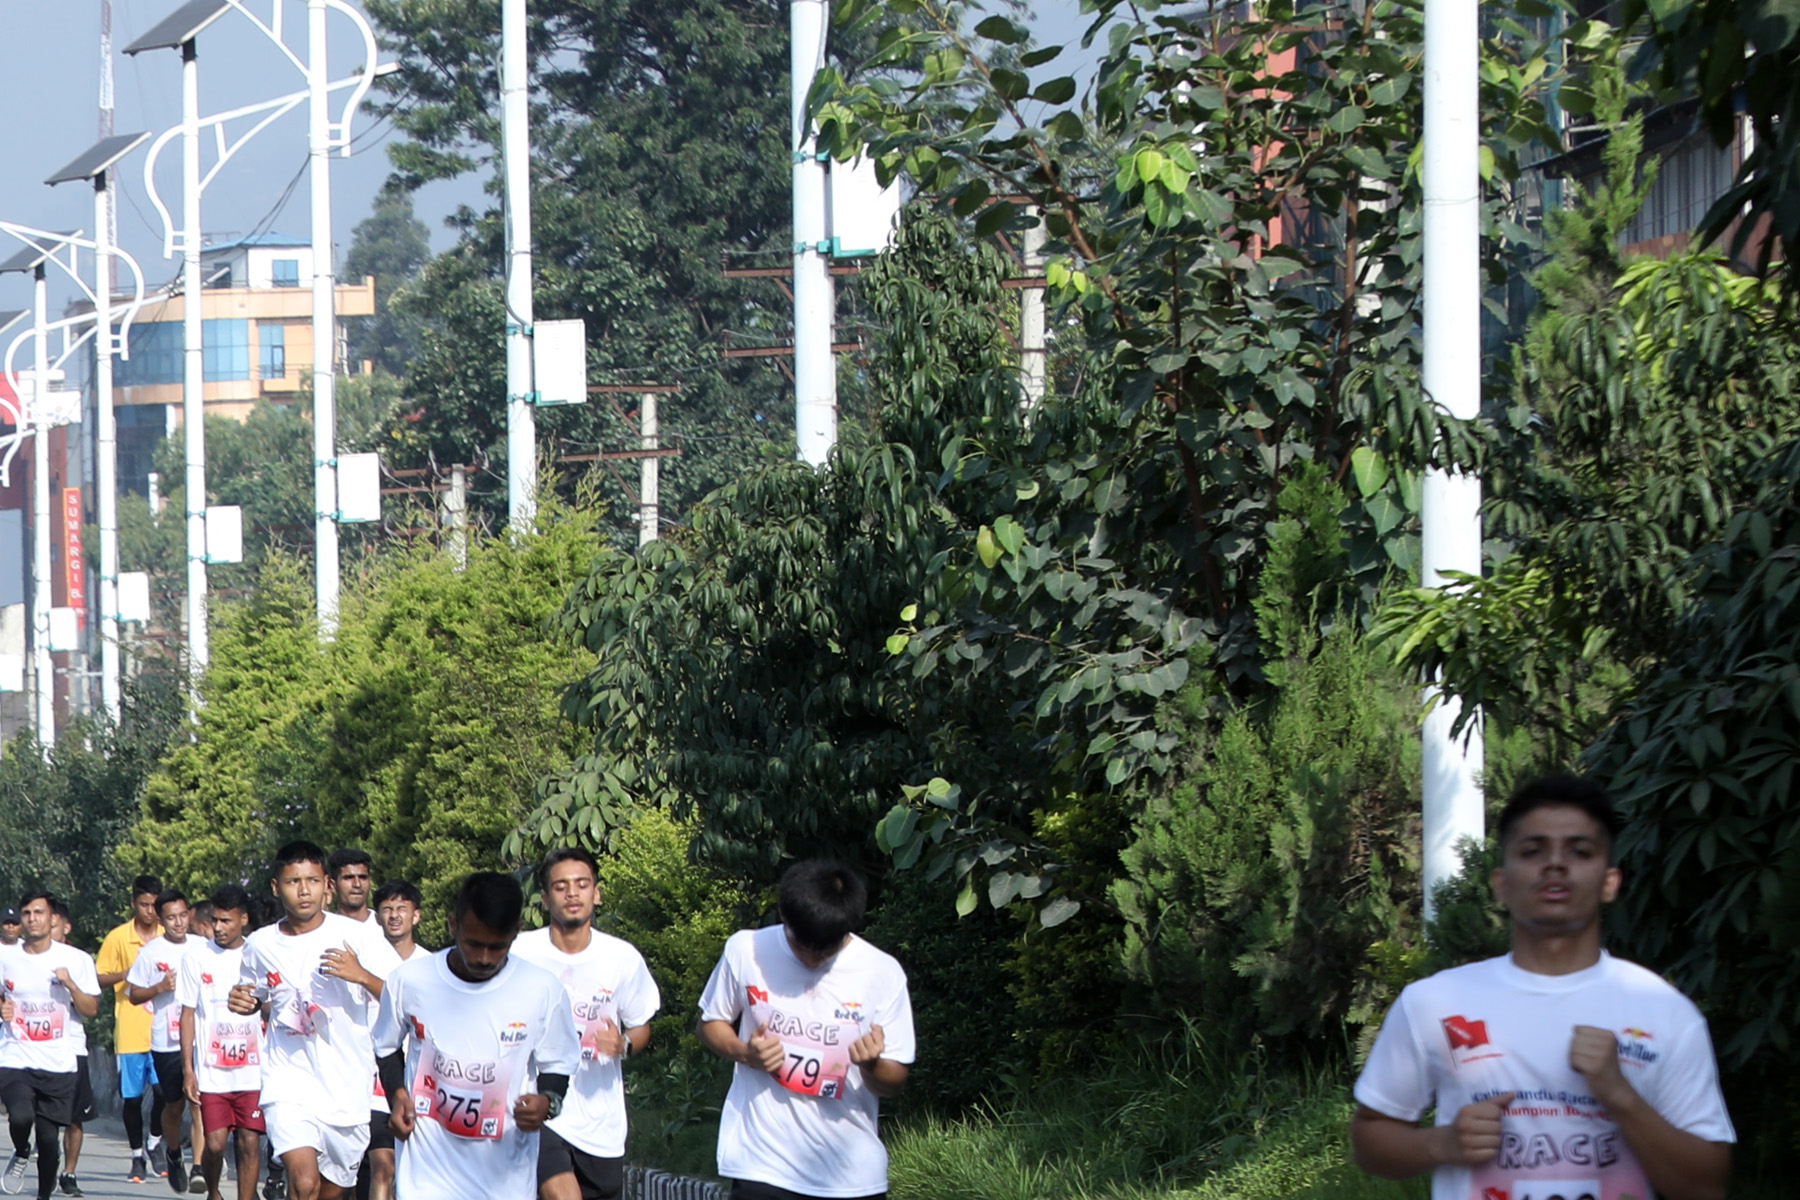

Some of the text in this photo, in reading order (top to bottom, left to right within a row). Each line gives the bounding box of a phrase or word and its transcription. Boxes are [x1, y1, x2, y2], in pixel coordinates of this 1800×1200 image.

[68, 494, 81, 583] SUMARGI
[21, 1001, 56, 1013] RACE
[25, 1020, 51, 1037] 179
[216, 1022, 252, 1036] RACE
[768, 1010, 840, 1046] RACE
[221, 1043, 247, 1061] 145
[432, 1051, 496, 1085] RACE
[771, 1053, 821, 1088] 79
[436, 1088, 481, 1128] 275
[1497, 1131, 1619, 1169] RACE
